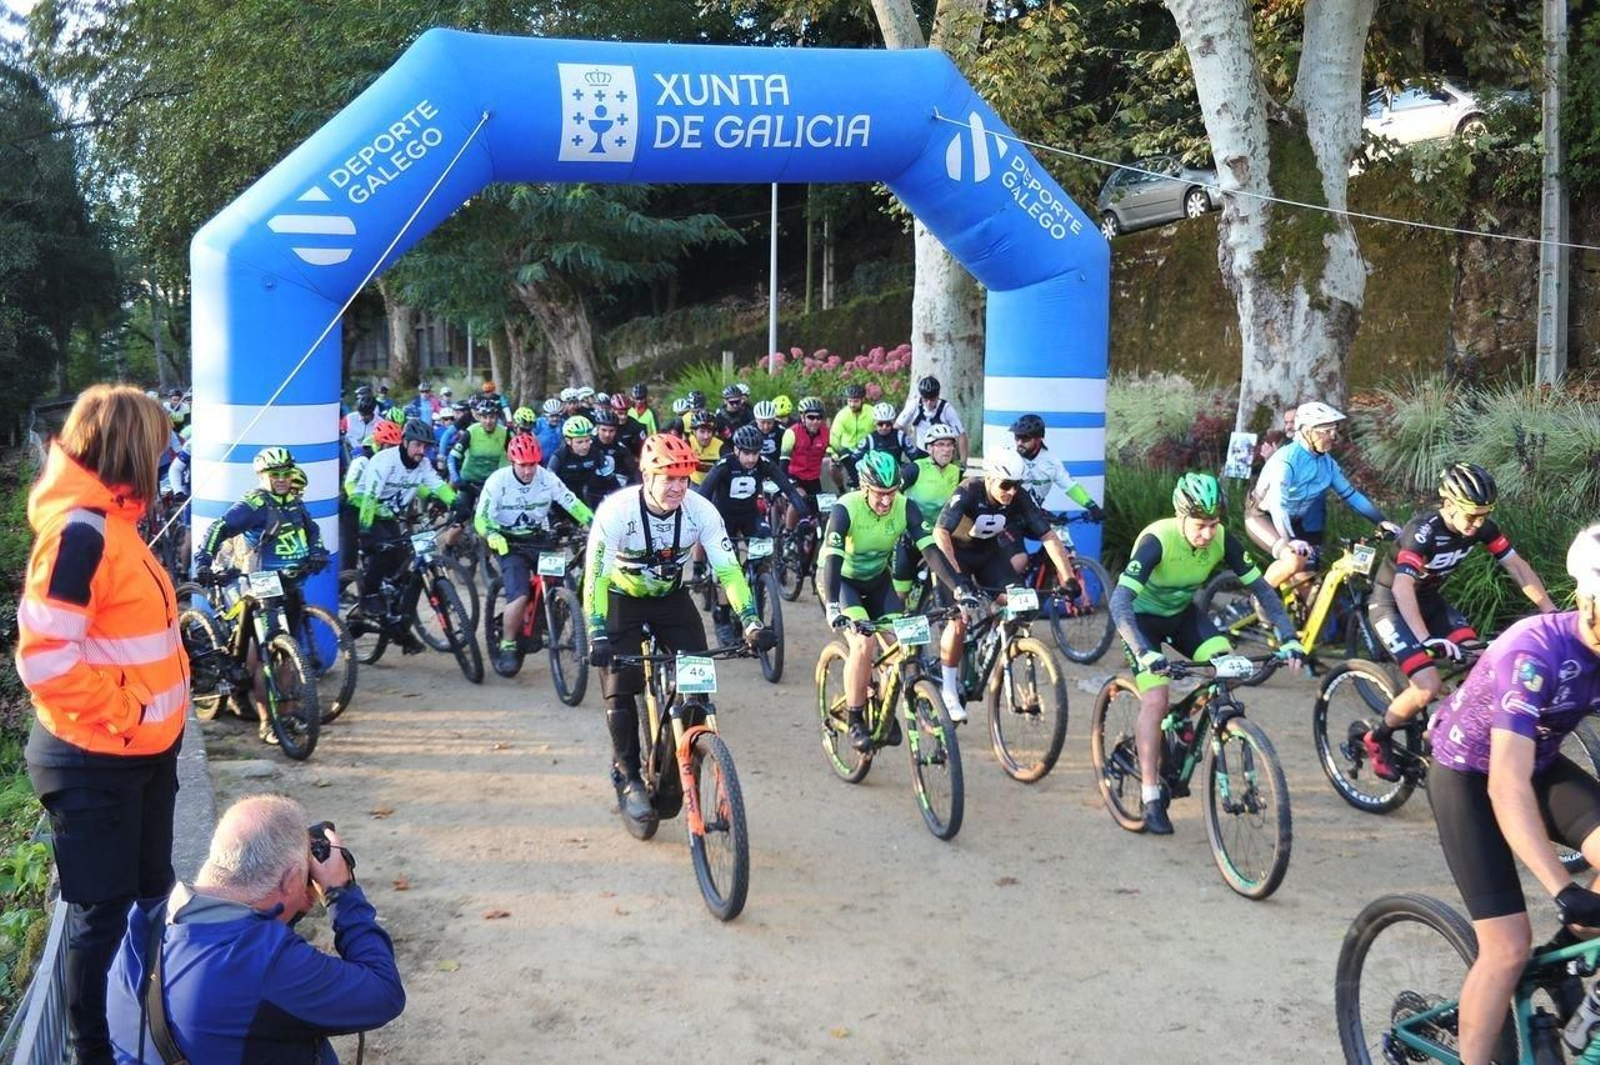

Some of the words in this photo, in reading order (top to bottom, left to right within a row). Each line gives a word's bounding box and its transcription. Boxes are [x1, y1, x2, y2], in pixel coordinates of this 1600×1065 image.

[653, 73, 790, 106] XUNTA
[328, 99, 439, 188] DEPORTE
[653, 115, 704, 149] DE
[714, 114, 871, 148] GALICIA
[348, 127, 442, 204] GALEGO
[1002, 171, 1066, 239] GALEGO
[1011, 155, 1082, 235] DEPORTE
[730, 476, 757, 499] B
[968, 513, 1006, 539] B
[1424, 545, 1475, 570] BH
[689, 667, 706, 677] 46
